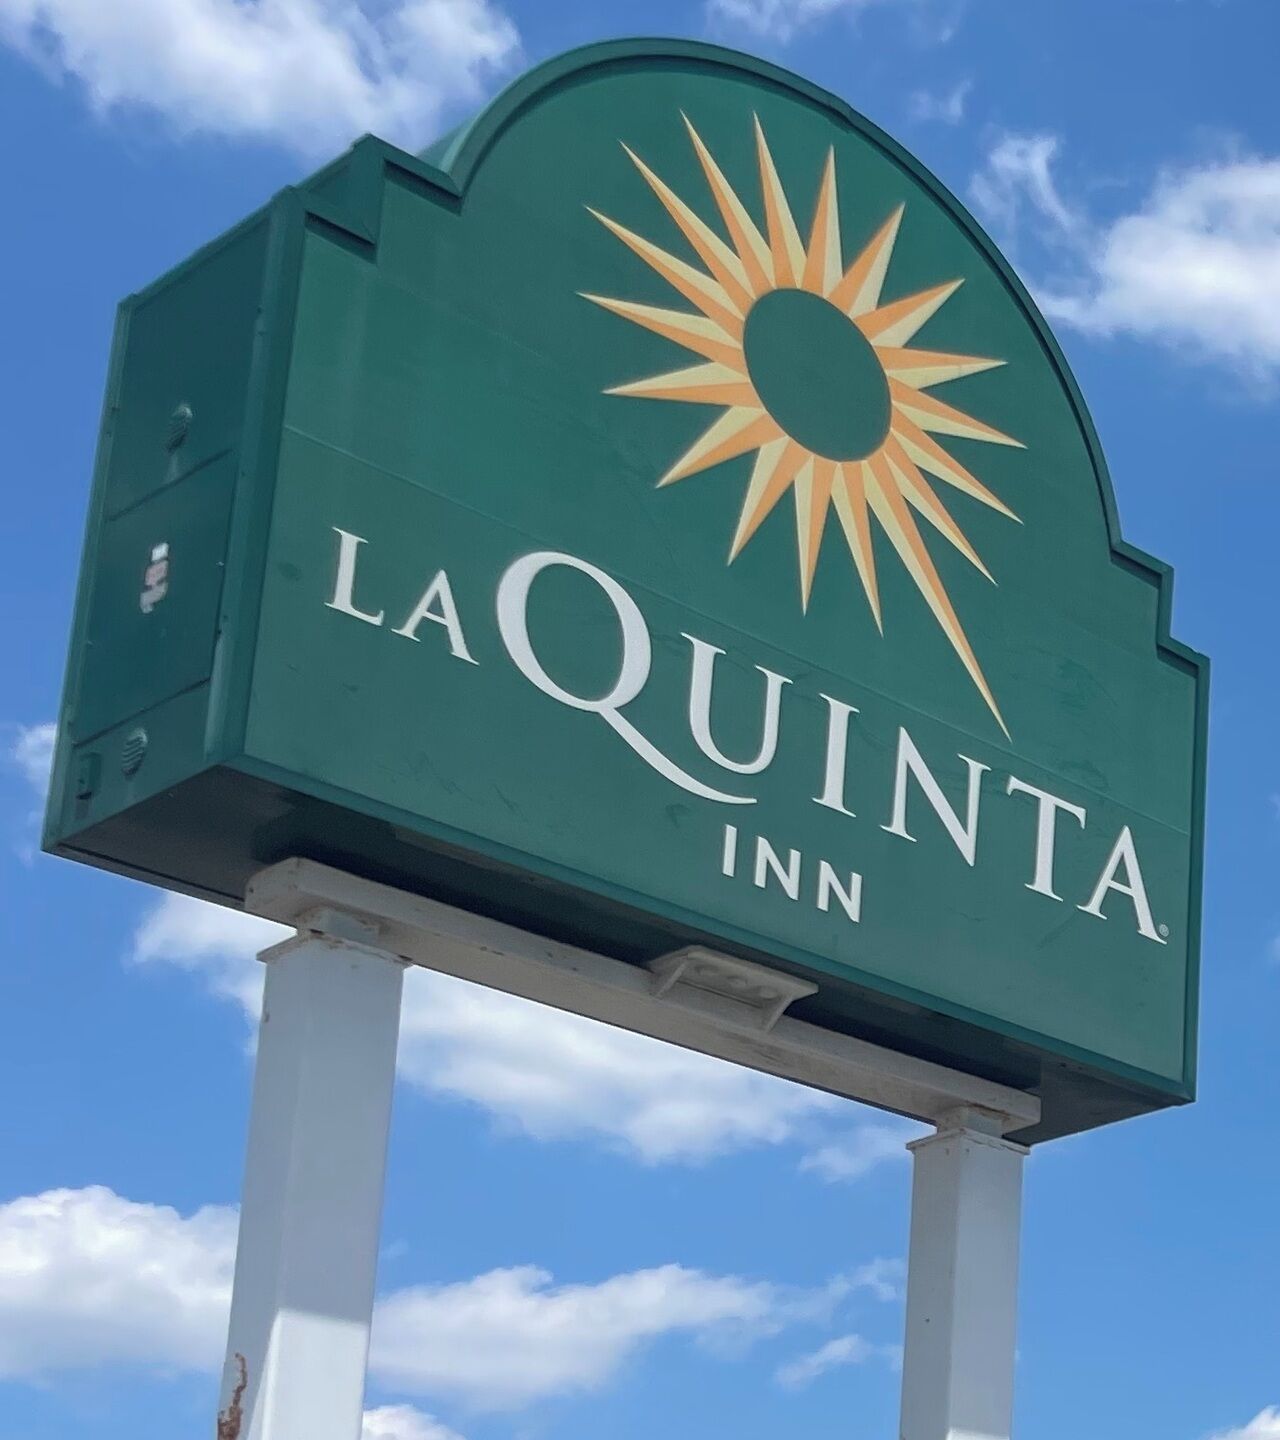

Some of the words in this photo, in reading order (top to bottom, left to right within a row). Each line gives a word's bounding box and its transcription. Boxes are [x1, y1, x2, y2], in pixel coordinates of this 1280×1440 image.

[325, 527, 480, 666] LA
[496, 551, 1168, 945] QUINTA
[723, 824, 863, 923] INN
